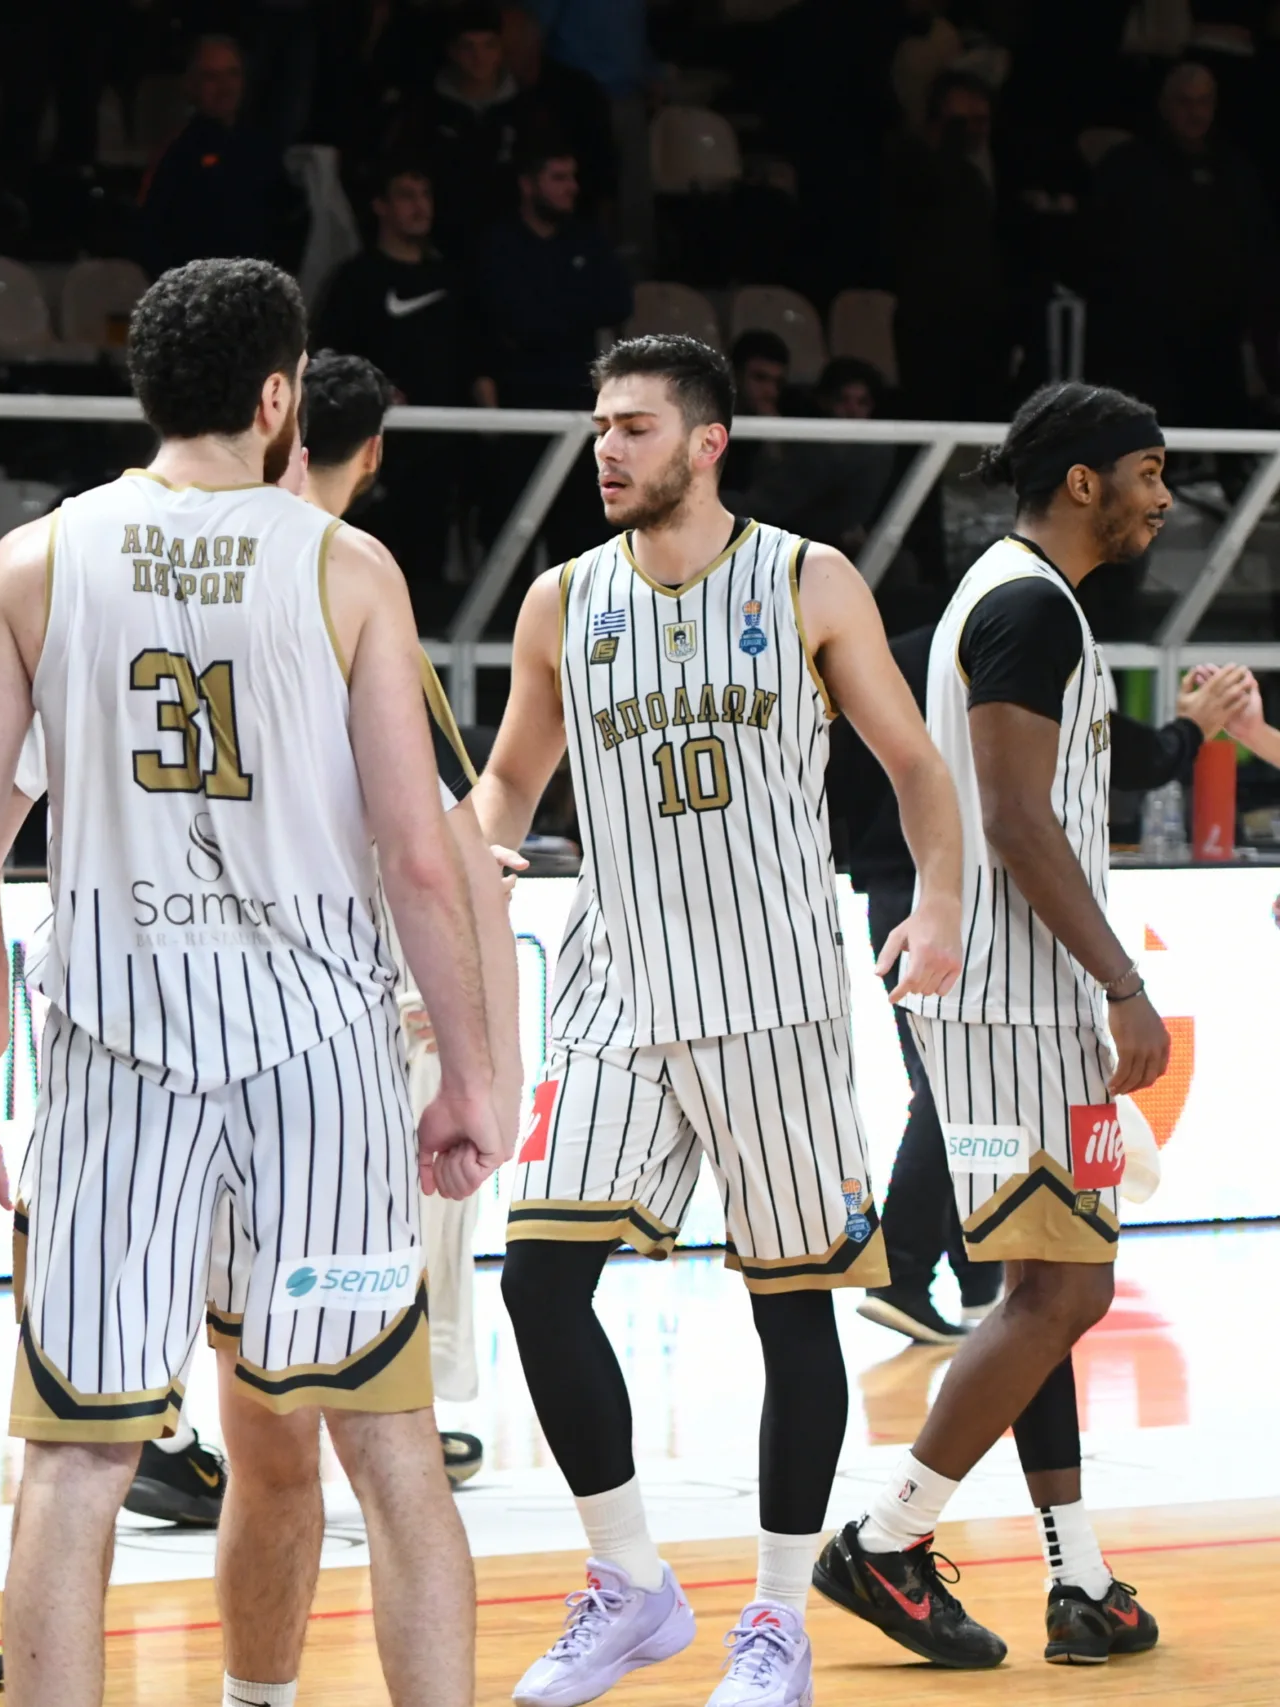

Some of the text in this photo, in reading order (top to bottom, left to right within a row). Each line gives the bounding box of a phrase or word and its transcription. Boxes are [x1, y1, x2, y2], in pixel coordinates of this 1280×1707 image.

[121, 523, 259, 569] ΑΠΛΛΩΝ
[130, 648, 253, 801] 31
[593, 683, 778, 751] ΑΠΟΛΛΩΝ
[652, 734, 733, 818] 10
